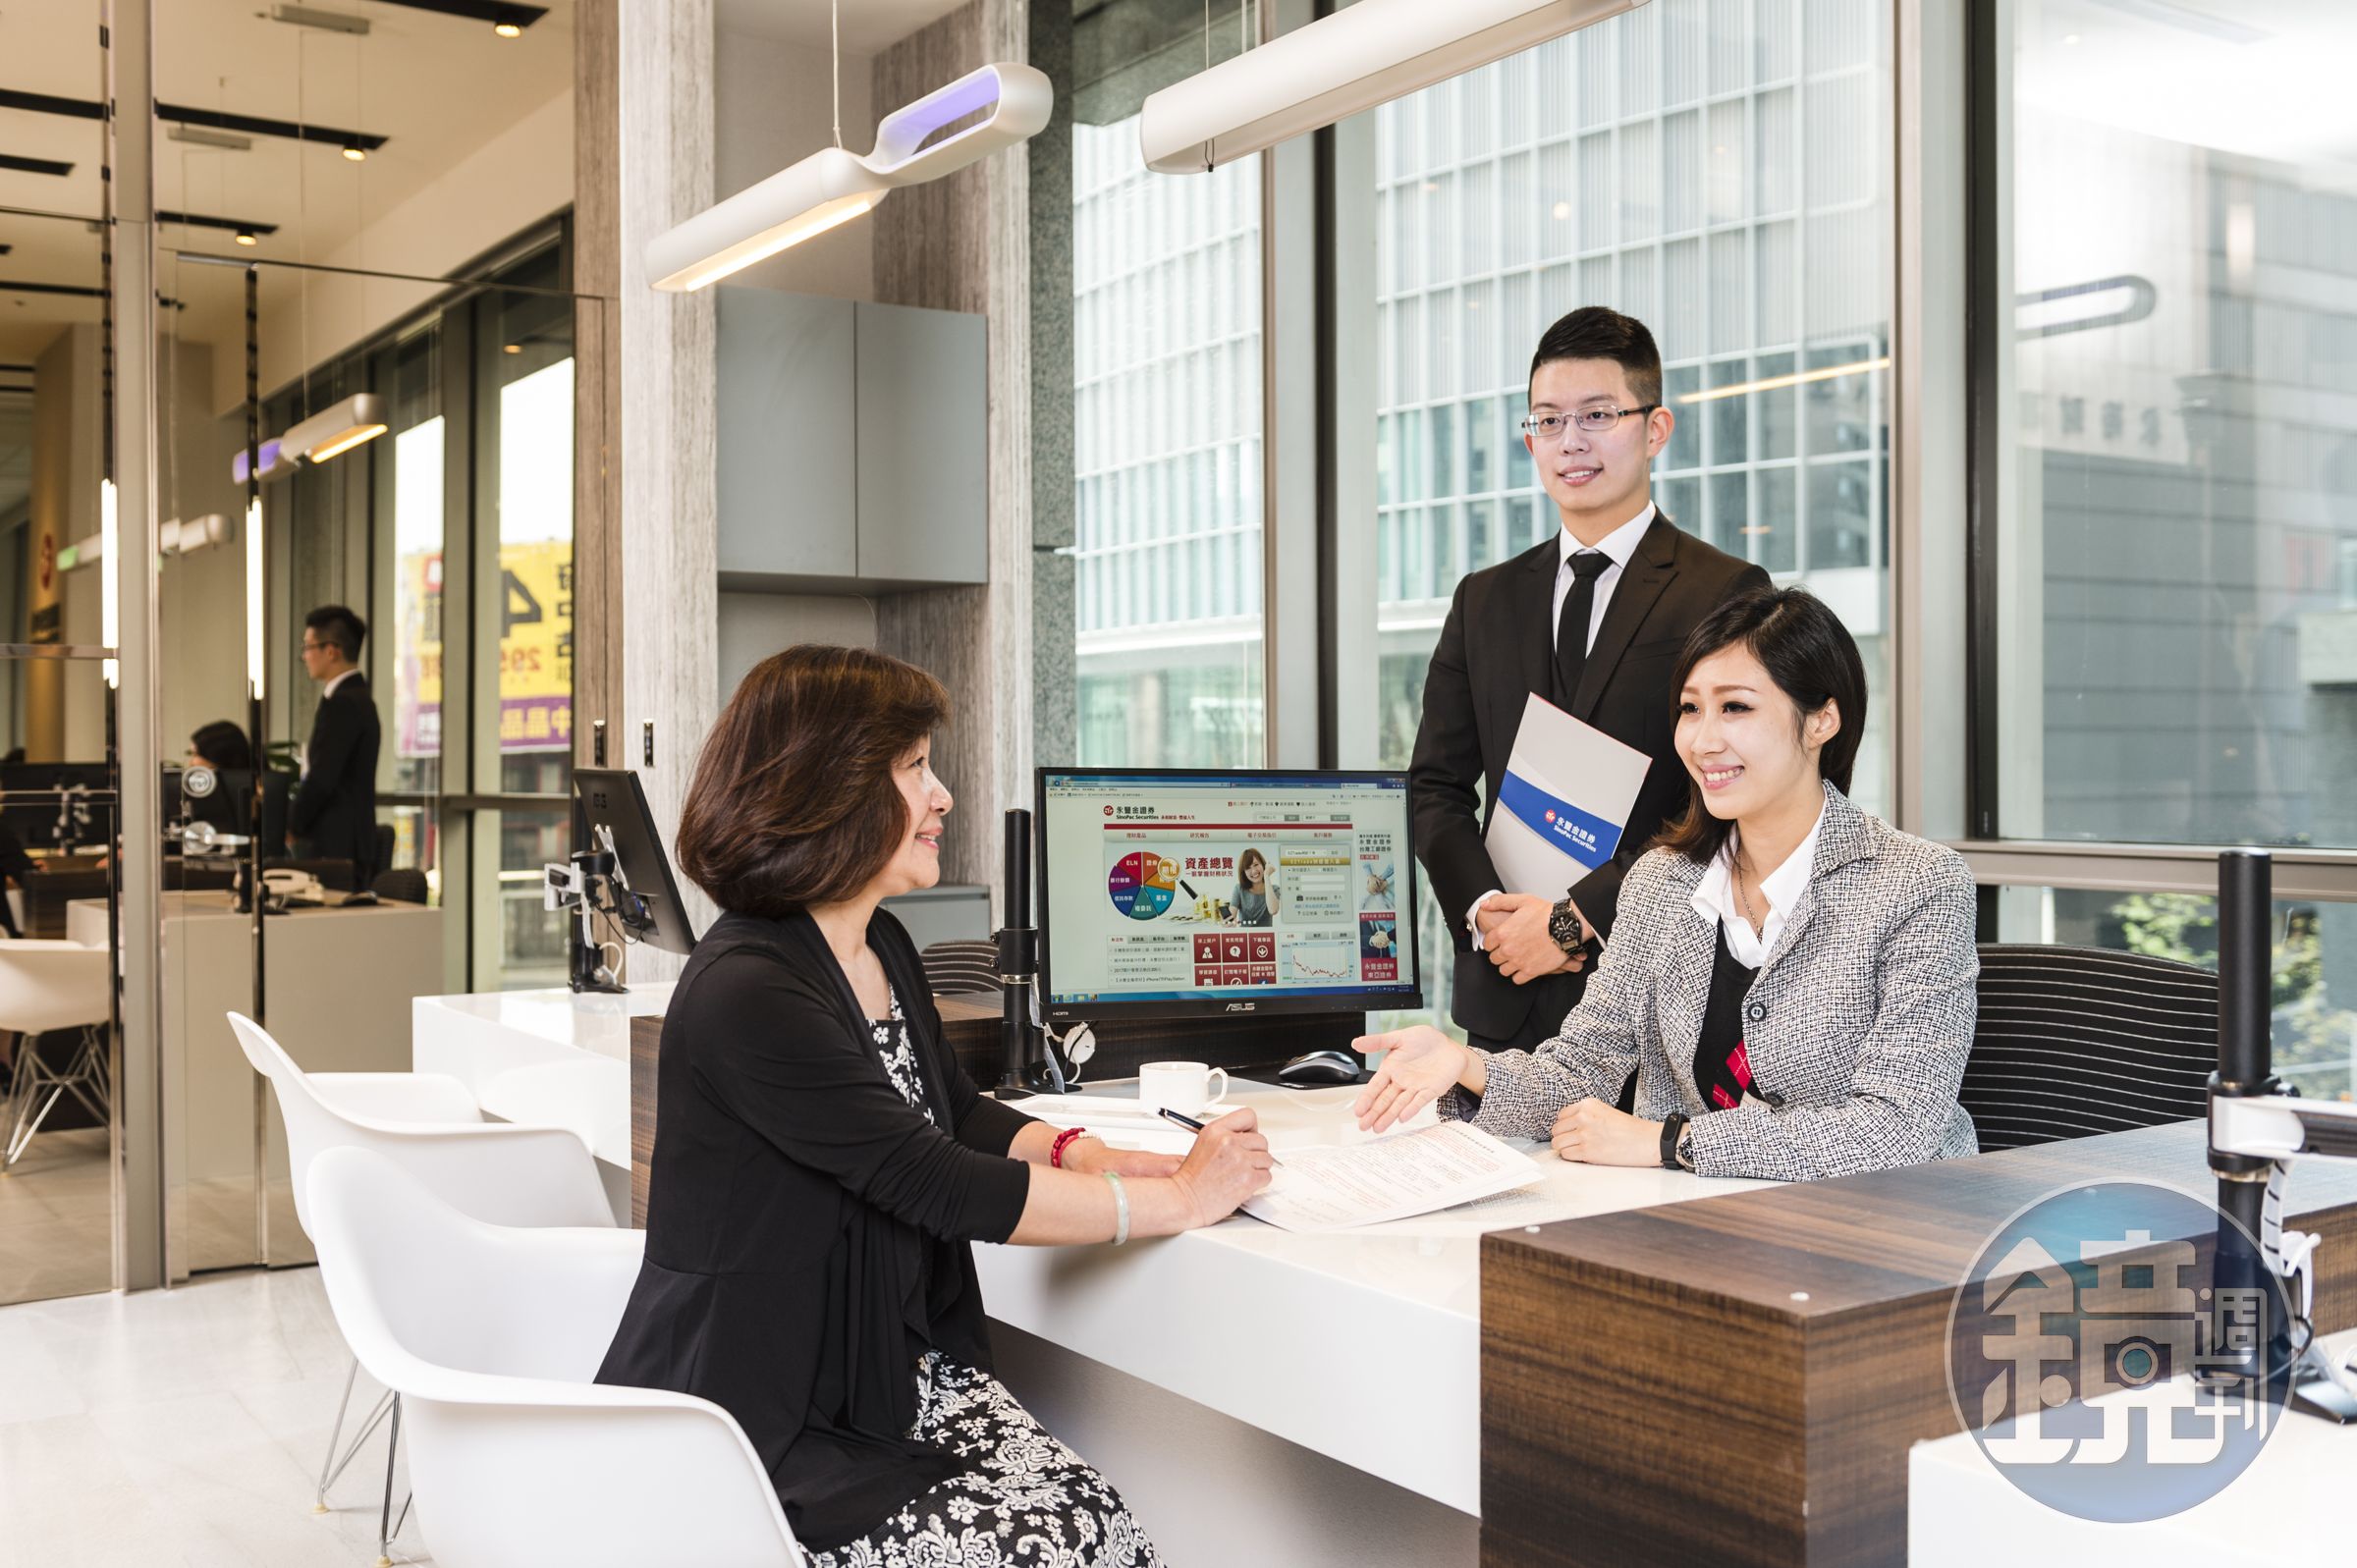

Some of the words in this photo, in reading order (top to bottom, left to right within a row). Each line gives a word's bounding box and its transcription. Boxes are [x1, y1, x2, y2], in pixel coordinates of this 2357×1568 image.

[1554, 825, 1572, 839] SinoPac
[1571, 836, 1597, 852] Securities
[1184, 857, 1233, 870] 資產總覽
[1225, 1002, 1256, 1012] ASUS
